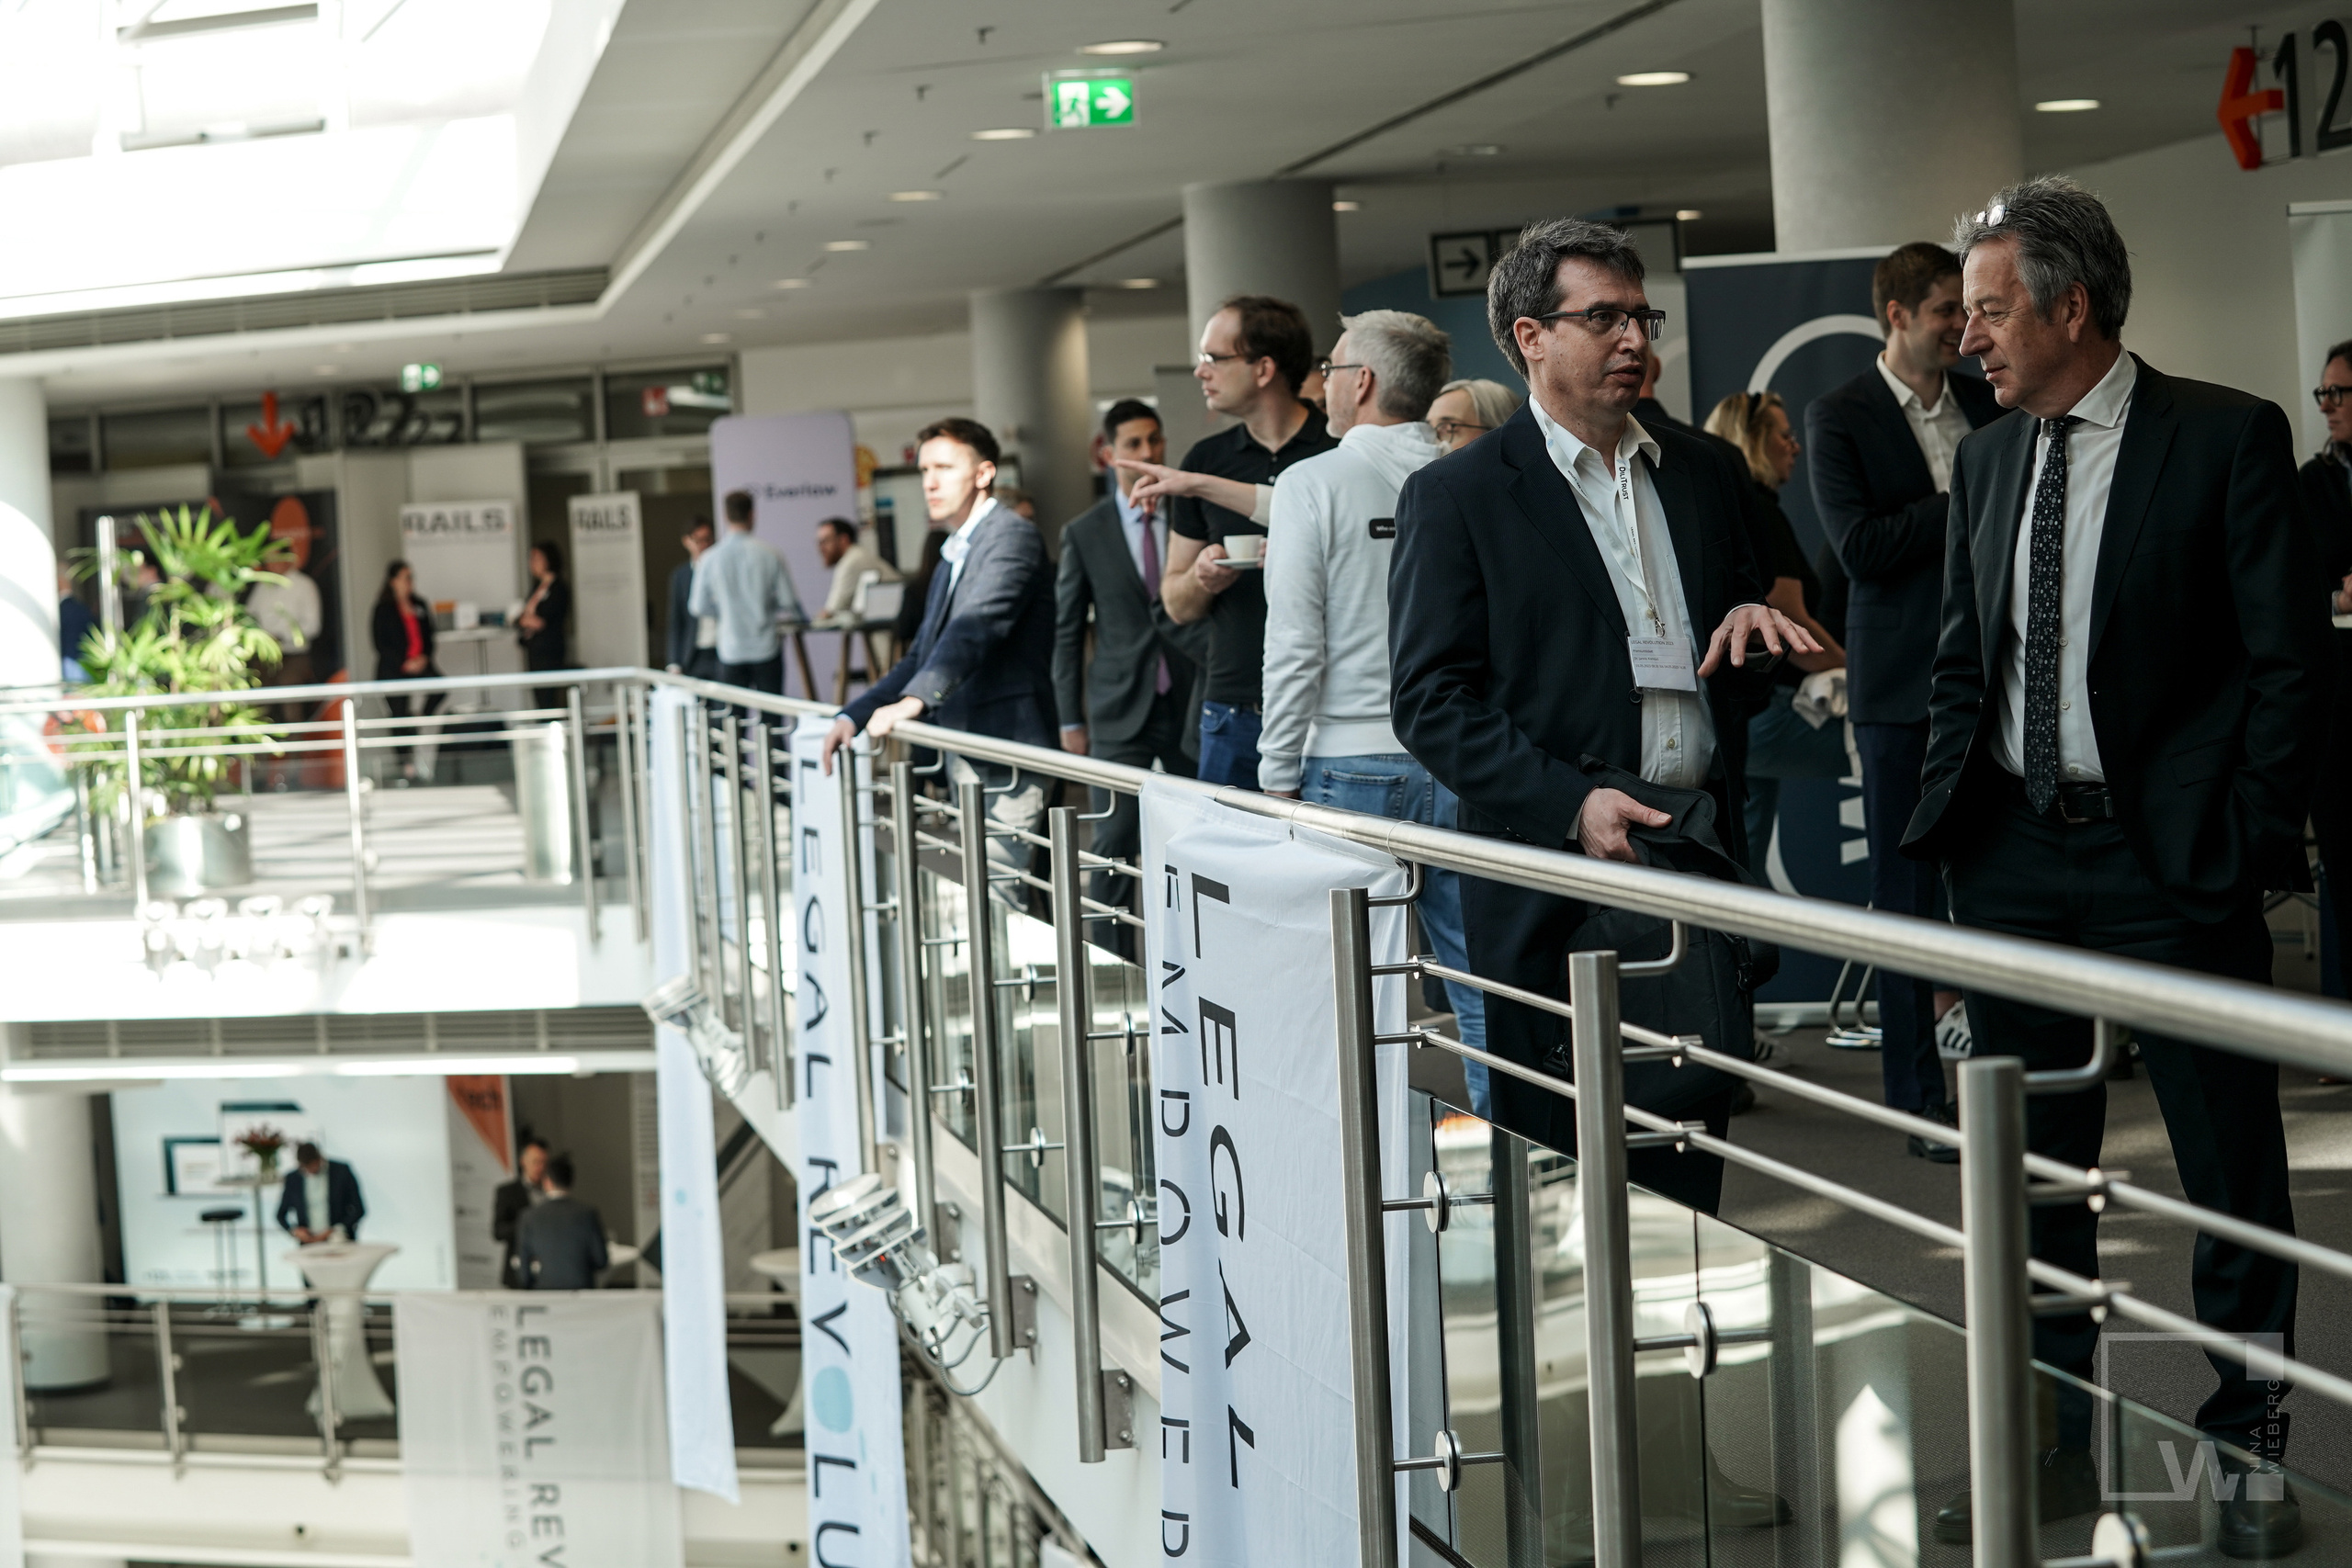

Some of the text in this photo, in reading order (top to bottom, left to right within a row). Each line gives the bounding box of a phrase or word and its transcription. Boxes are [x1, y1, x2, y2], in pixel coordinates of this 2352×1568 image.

[799, 760, 832, 1099] LEGAL
[1192, 872, 1255, 1490] LEGAL
[516, 1305, 570, 1568] LEGAL REV
